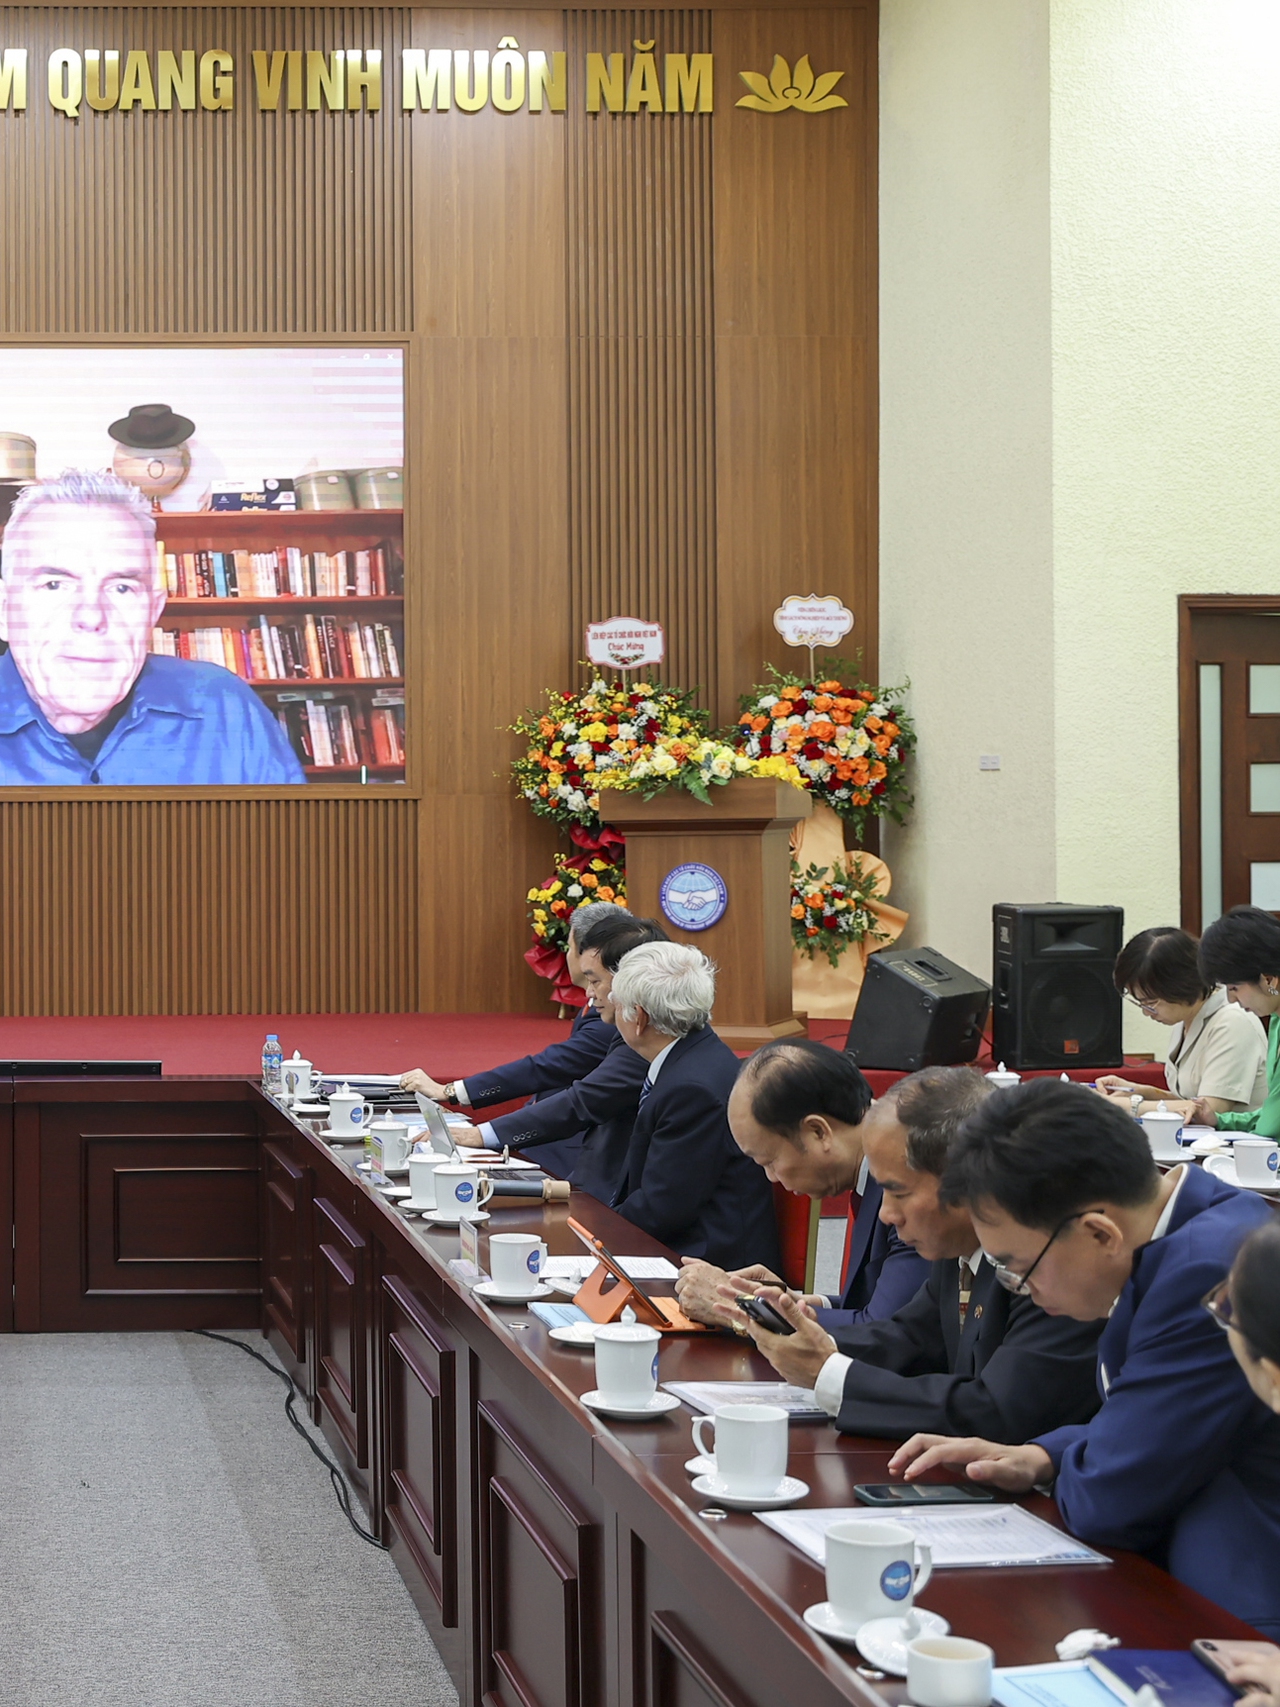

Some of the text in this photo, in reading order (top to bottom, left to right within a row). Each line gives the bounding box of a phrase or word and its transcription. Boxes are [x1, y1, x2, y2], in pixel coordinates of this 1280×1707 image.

[48, 47, 234, 118] QUANG
[252, 48, 382, 112] VINH
[402, 35, 566, 111] MUÔN
[586, 40, 713, 113] NĂM
